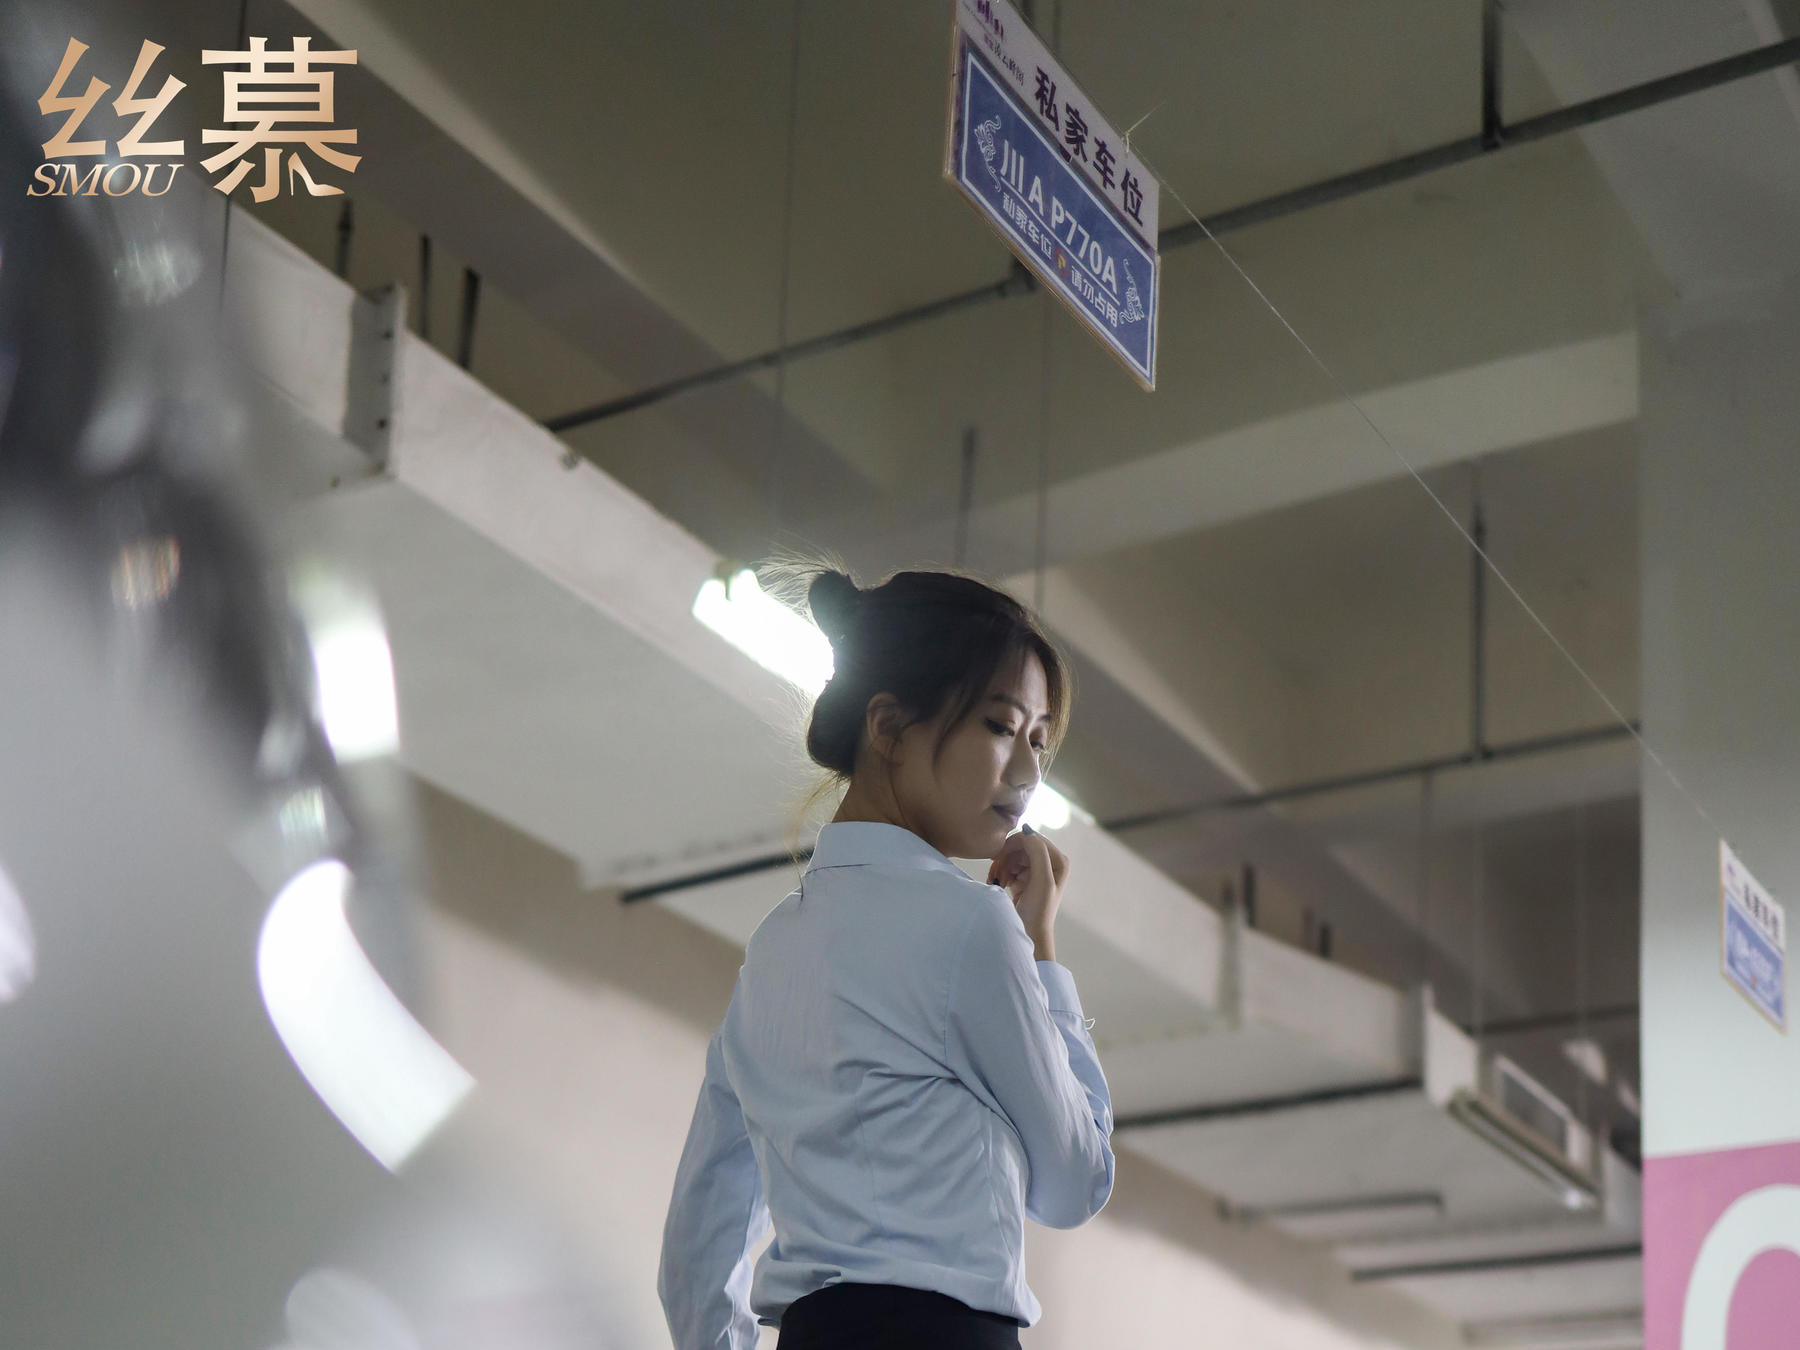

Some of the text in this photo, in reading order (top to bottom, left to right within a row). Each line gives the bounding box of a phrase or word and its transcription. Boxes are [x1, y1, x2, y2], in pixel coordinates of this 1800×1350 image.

[1035, 65, 1144, 227] 私家车位
[1002, 191, 1053, 260] 私家车位
[1051, 197, 1118, 293] P770A
